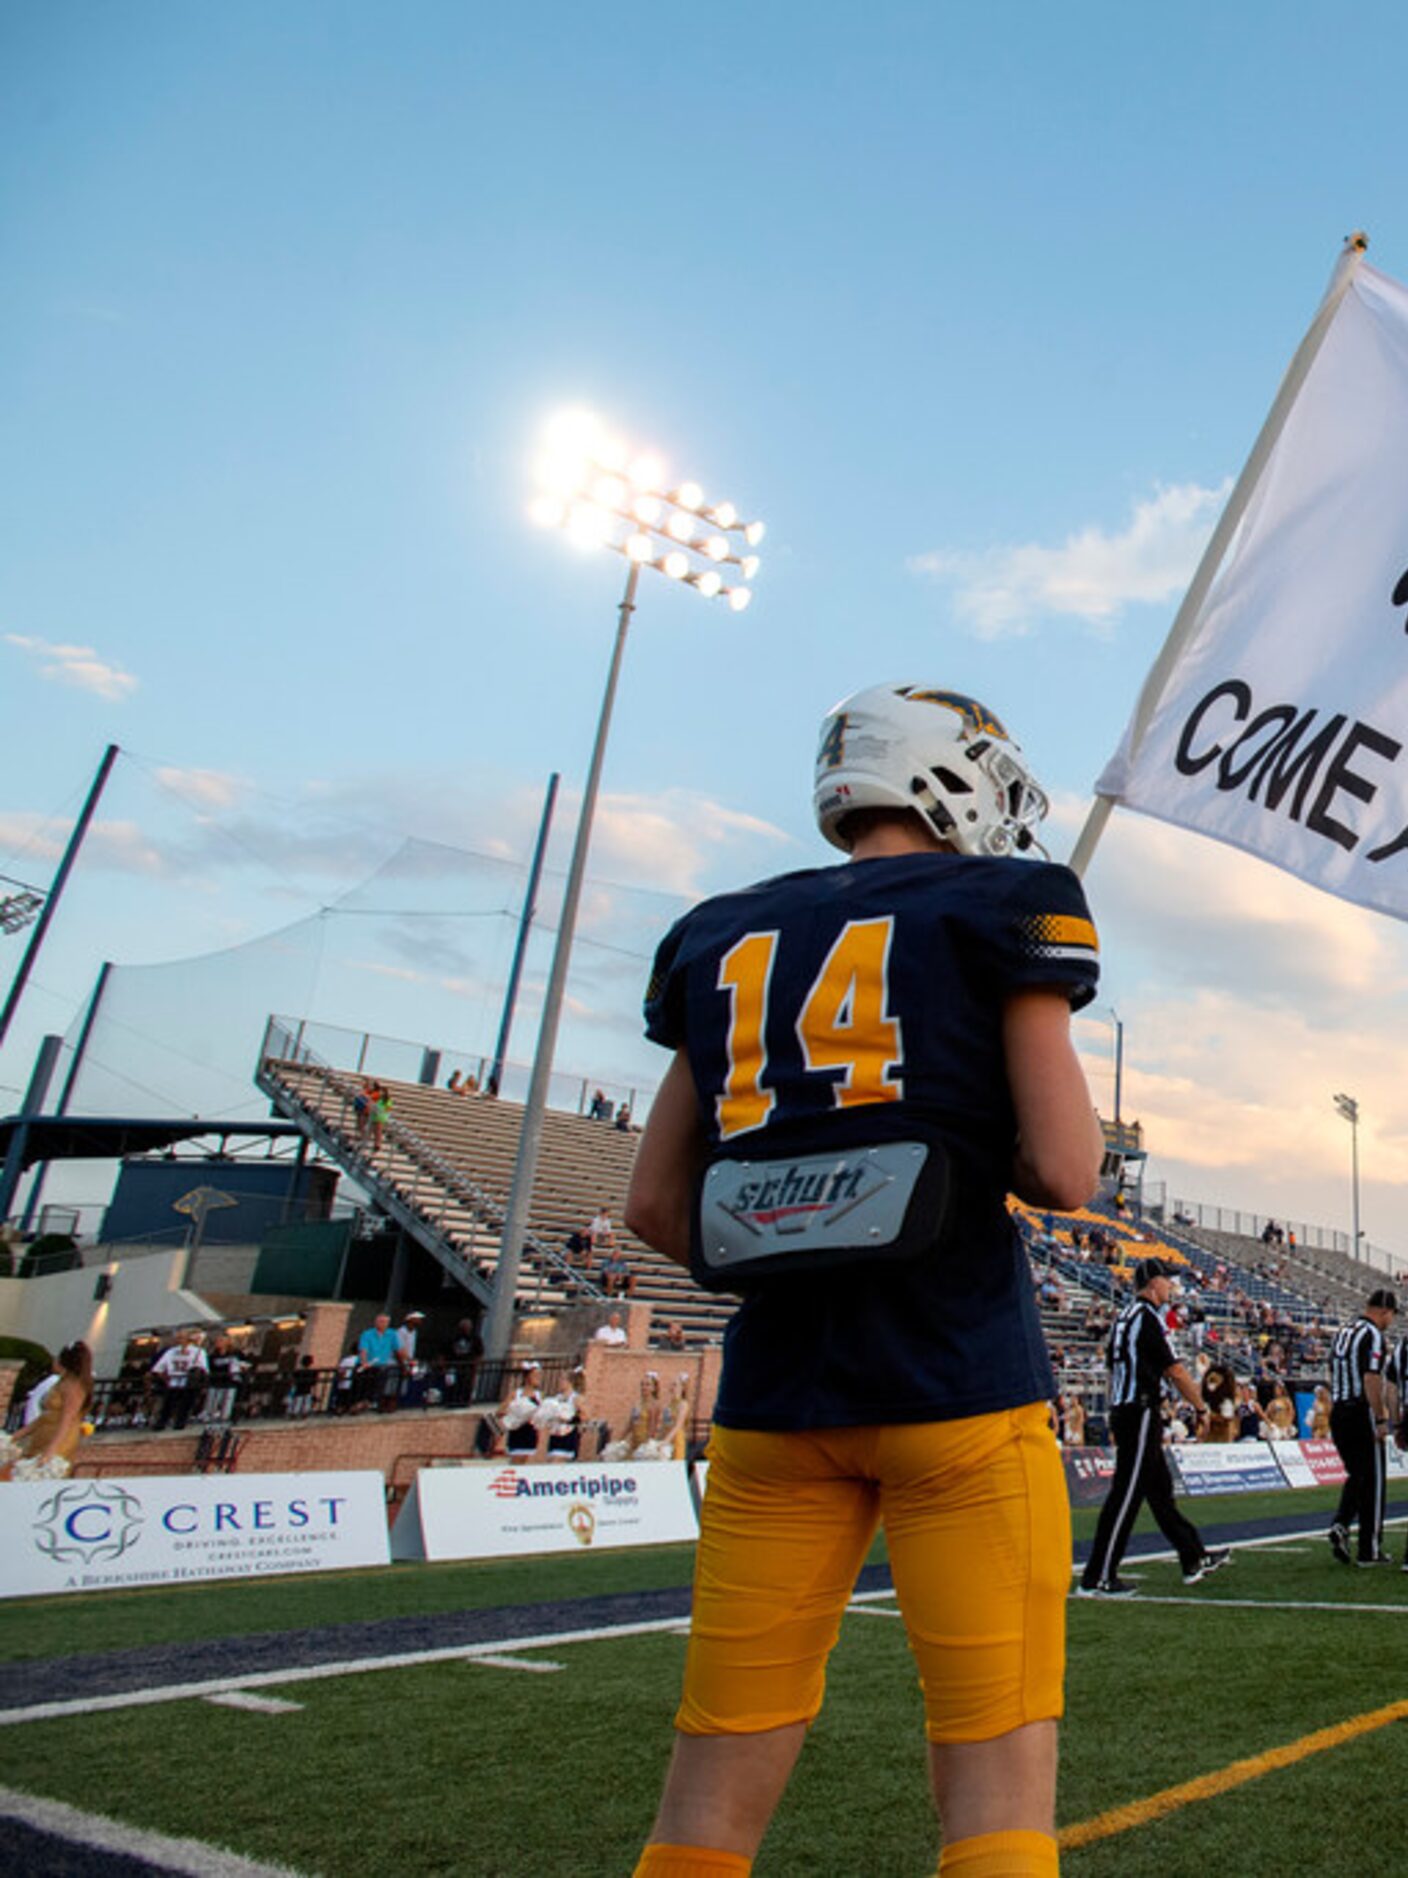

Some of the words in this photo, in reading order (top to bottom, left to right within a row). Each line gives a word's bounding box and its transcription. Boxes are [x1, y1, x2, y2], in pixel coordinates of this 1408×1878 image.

[1175, 679, 1403, 852] COME
[716, 914, 904, 1142] 14
[516, 1474, 637, 1498] Ameripipe
[65, 1503, 112, 1543] C
[162, 1498, 347, 1534] CREST
